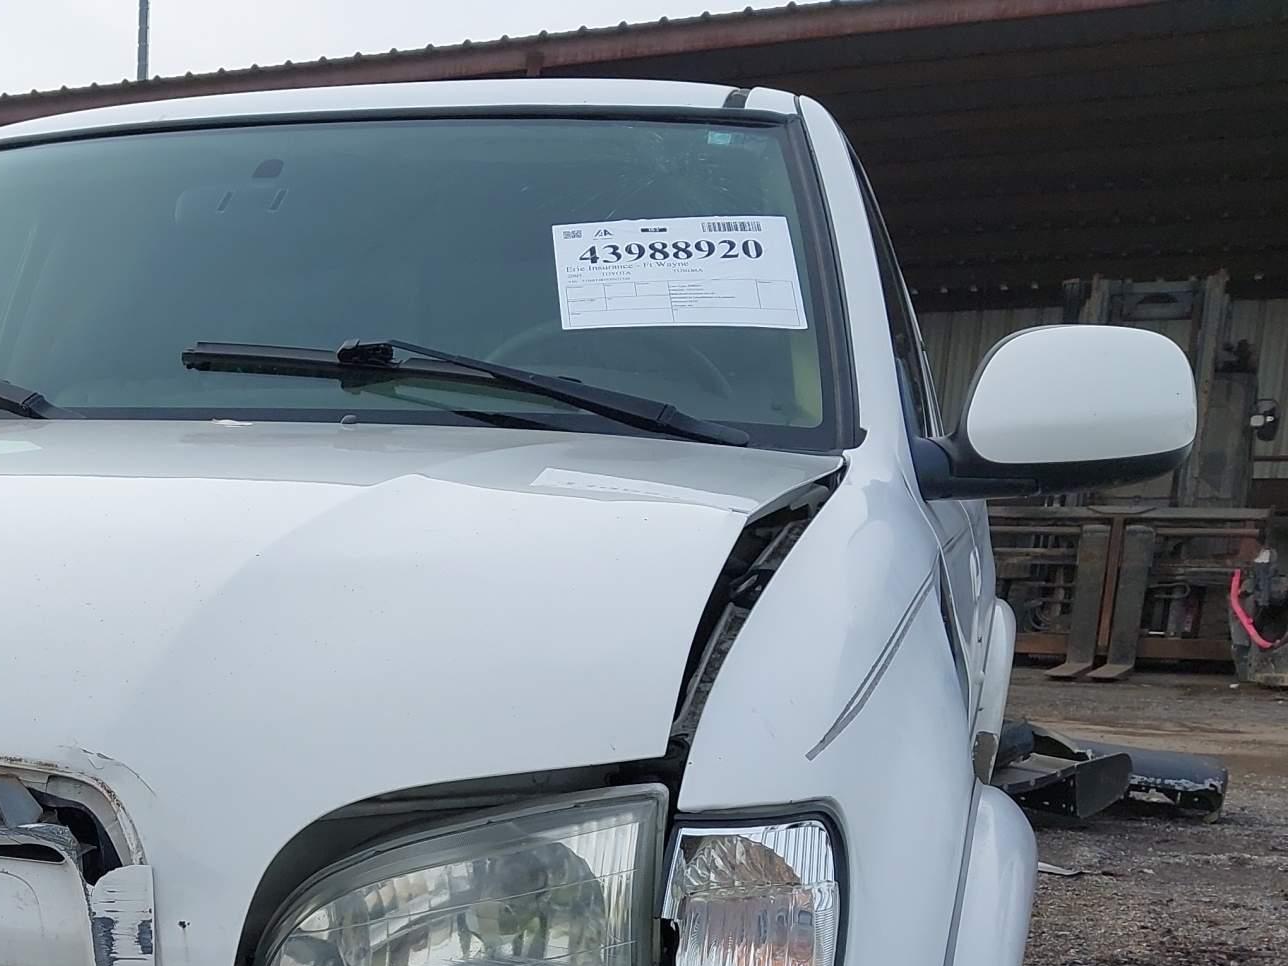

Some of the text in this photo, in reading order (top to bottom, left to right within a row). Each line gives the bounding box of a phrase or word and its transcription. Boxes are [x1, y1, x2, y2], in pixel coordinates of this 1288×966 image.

[579, 239, 764, 264] 43988920
[566, 265, 585, 273] Erie
[588, 263, 633, 272] Insurance
[656, 260, 689, 269] Wayne
